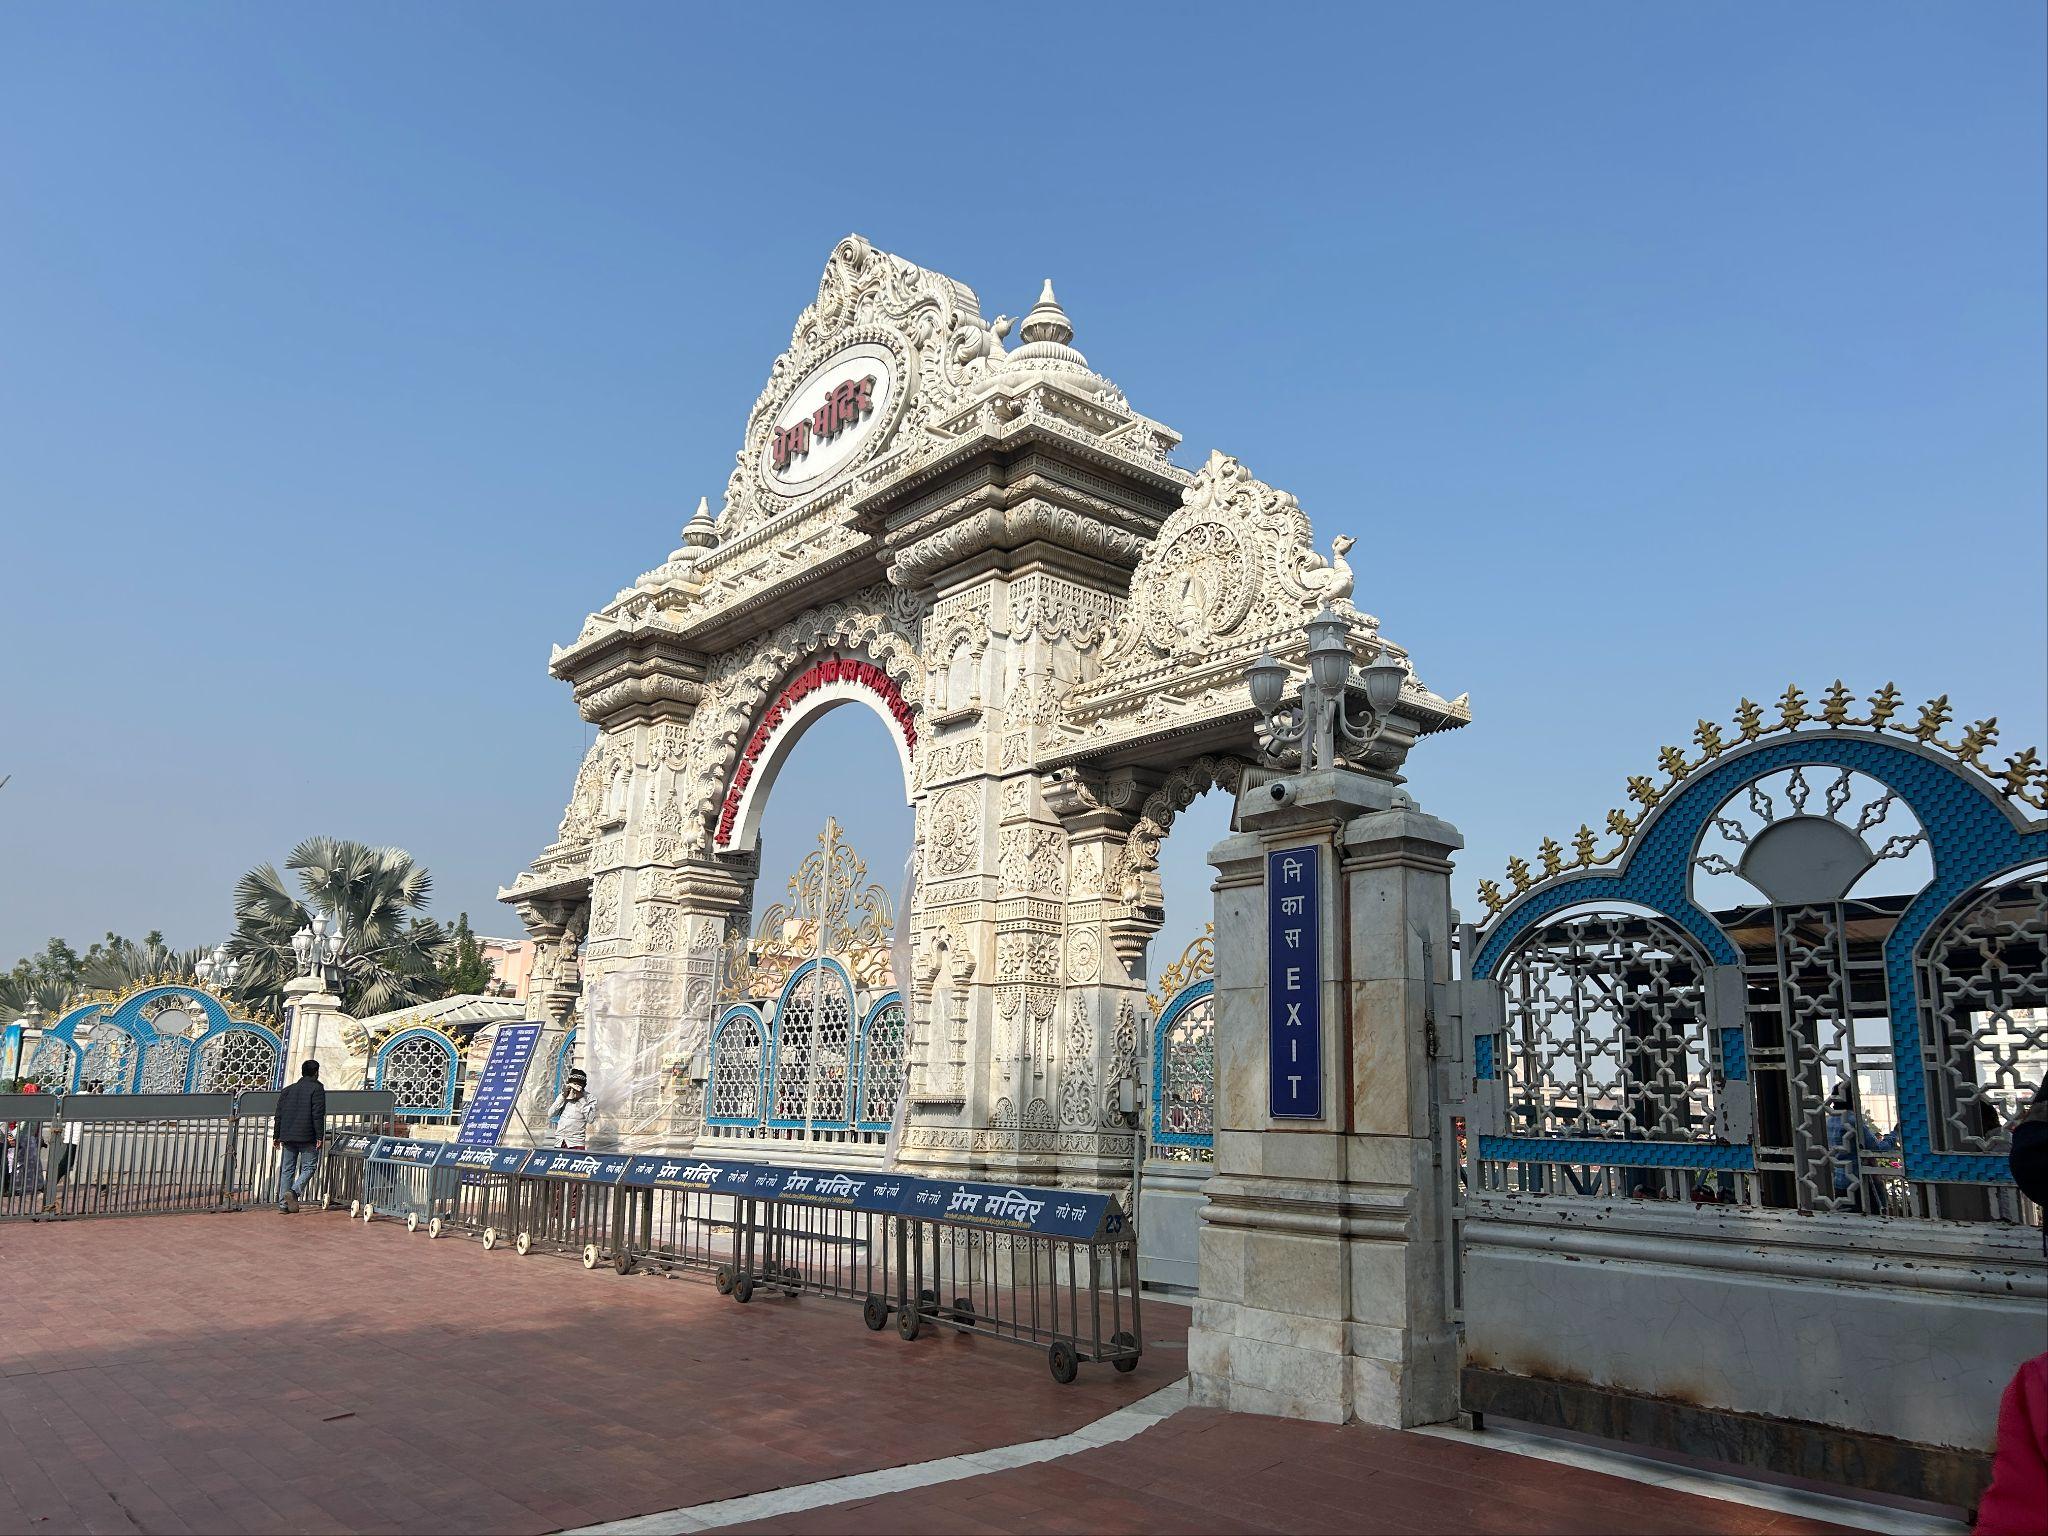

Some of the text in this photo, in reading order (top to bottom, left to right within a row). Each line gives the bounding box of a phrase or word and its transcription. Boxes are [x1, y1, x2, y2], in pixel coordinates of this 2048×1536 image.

[772, 417, 812, 471] प्रेम
[1281, 857, 1305, 948] निकास
[1286, 966, 1302, 1099] EXIT
[549, 1153, 570, 1170] प्रेम
[569, 1156, 602, 1174] मन्दिर
[656, 1160, 681, 1178] प्रेम
[682, 1162, 723, 1183] मन्दिर
[783, 1170, 814, 1191] प्रेम
[815, 1173, 866, 1197] मन्दिर
[873, 1182, 887, 1196] राधे
[886, 1182, 900, 1198] राधे
[916, 1189, 929, 1204] राधे
[928, 1190, 942, 1205] राधे
[946, 1185, 982, 1213] प्रेम
[985, 1189, 1045, 1223] मन्दिर
[1055, 1203, 1070, 1220] राधे
[1071, 1205, 1087, 1222] राधे
